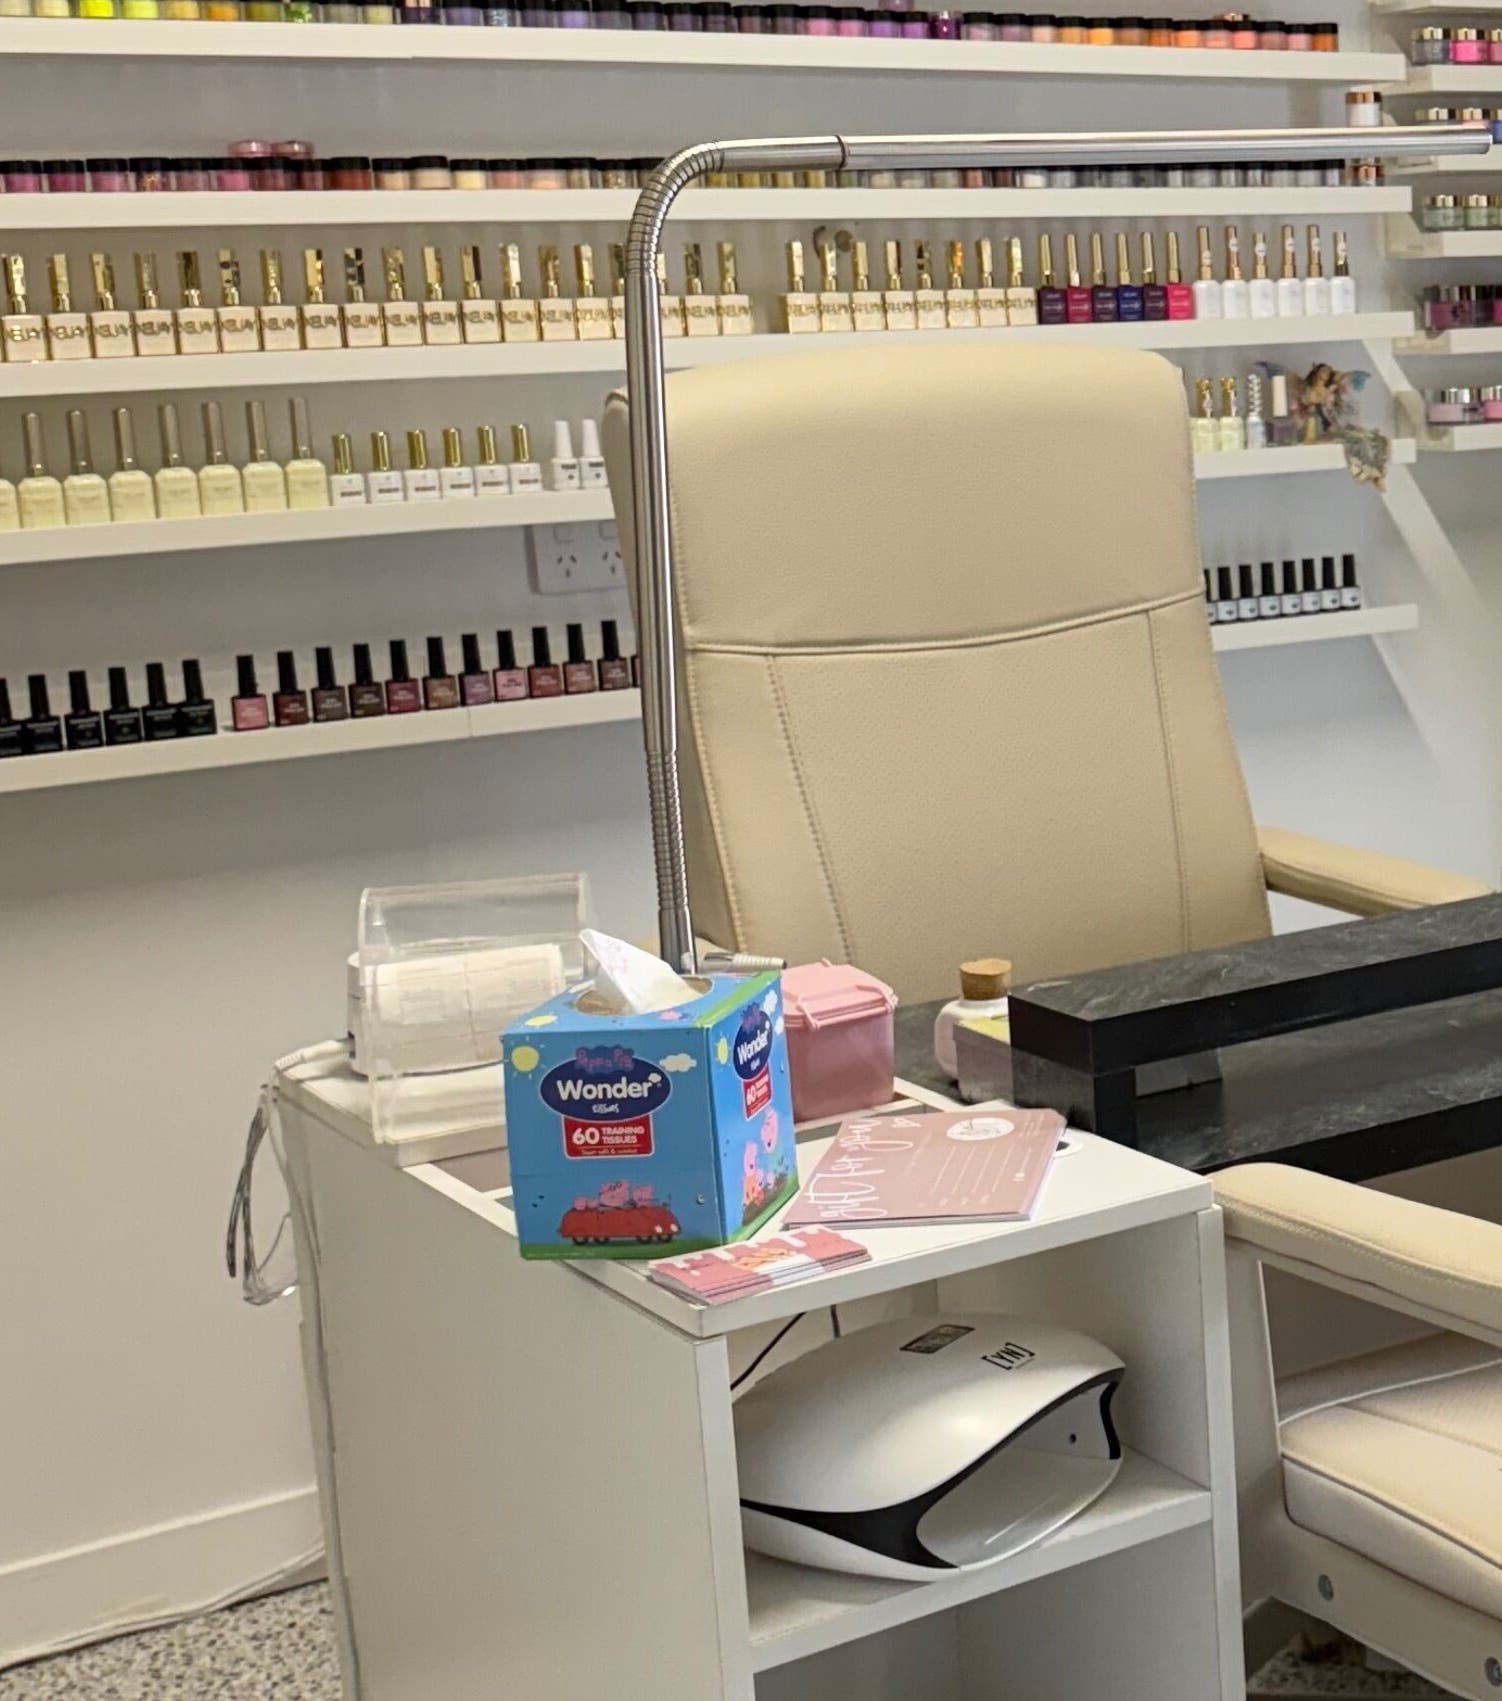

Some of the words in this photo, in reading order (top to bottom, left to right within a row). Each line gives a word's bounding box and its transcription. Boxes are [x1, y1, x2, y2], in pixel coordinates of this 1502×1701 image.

[556, 1076, 651, 1101] Wonder
[572, 1127, 600, 1145] 60
[601, 1126, 645, 1136] TRAINING
[602, 1135, 638, 1145] TISSUES
